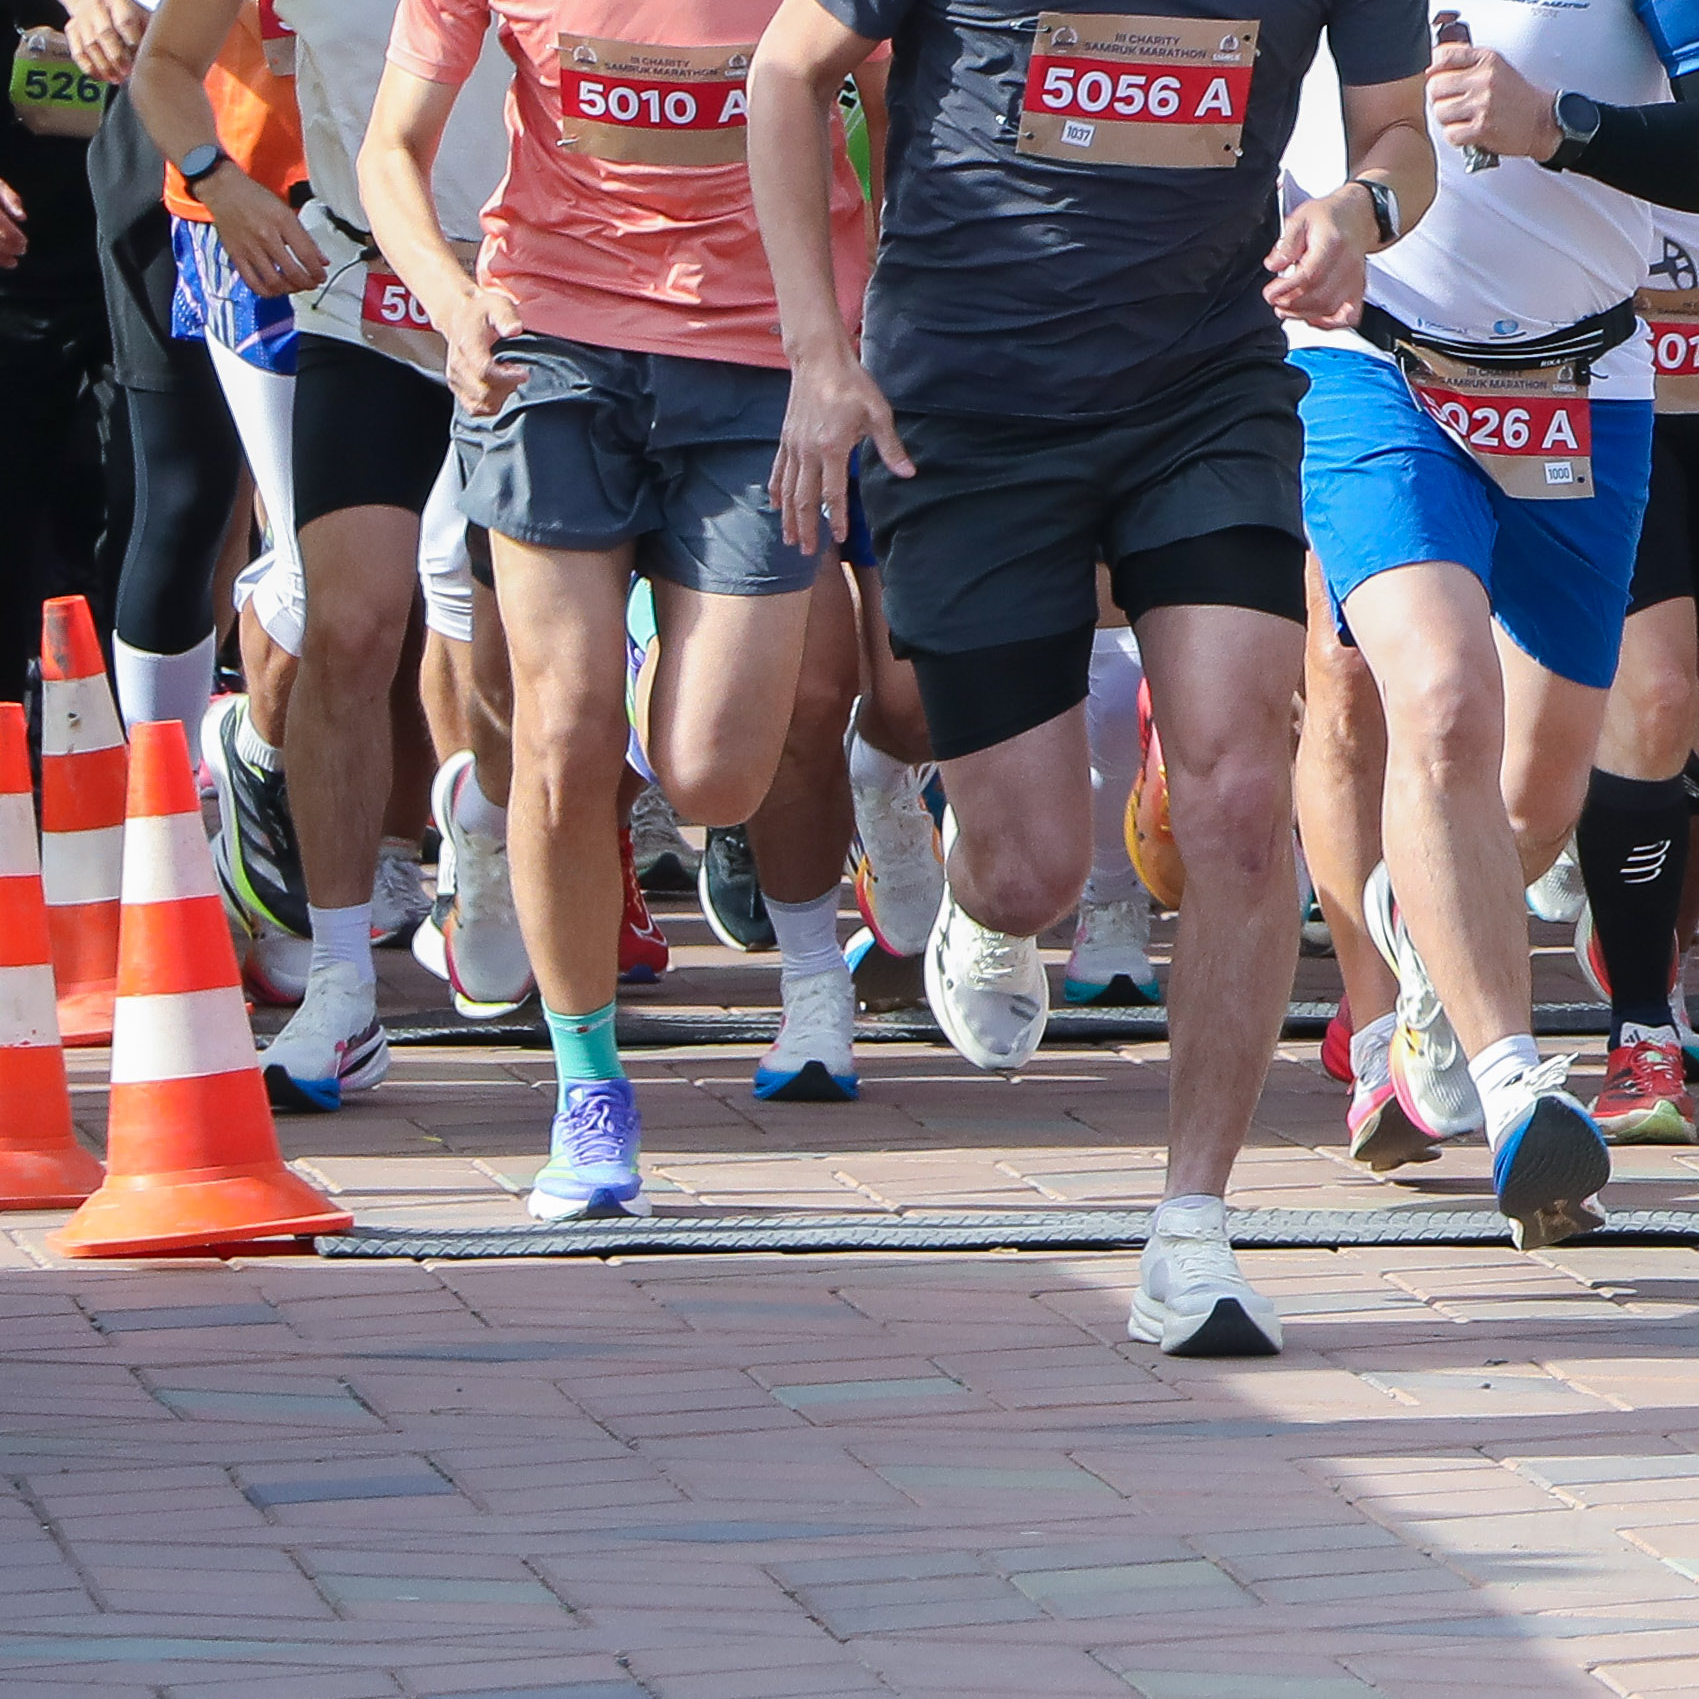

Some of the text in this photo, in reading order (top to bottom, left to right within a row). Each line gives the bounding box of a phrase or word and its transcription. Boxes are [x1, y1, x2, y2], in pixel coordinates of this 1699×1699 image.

[1131, 34, 1180, 46] CHARITY
[1084, 42, 1207, 60] SAMRUK MARATHON
[604, 62, 650, 75] SAMRUK
[652, 67, 718, 77] MARATHON
[642, 57, 690, 67] CHARITY
[1041, 66, 1233, 118] 5056 A
[578, 81, 747, 125] 5010 A
[1066, 125, 1091, 142] 1037
[380, 284, 430, 325] 50
[1489, 379, 1547, 390] MARATHON
[1541, 410, 1579, 449] A
[1549, 469, 1570, 480] 1000
